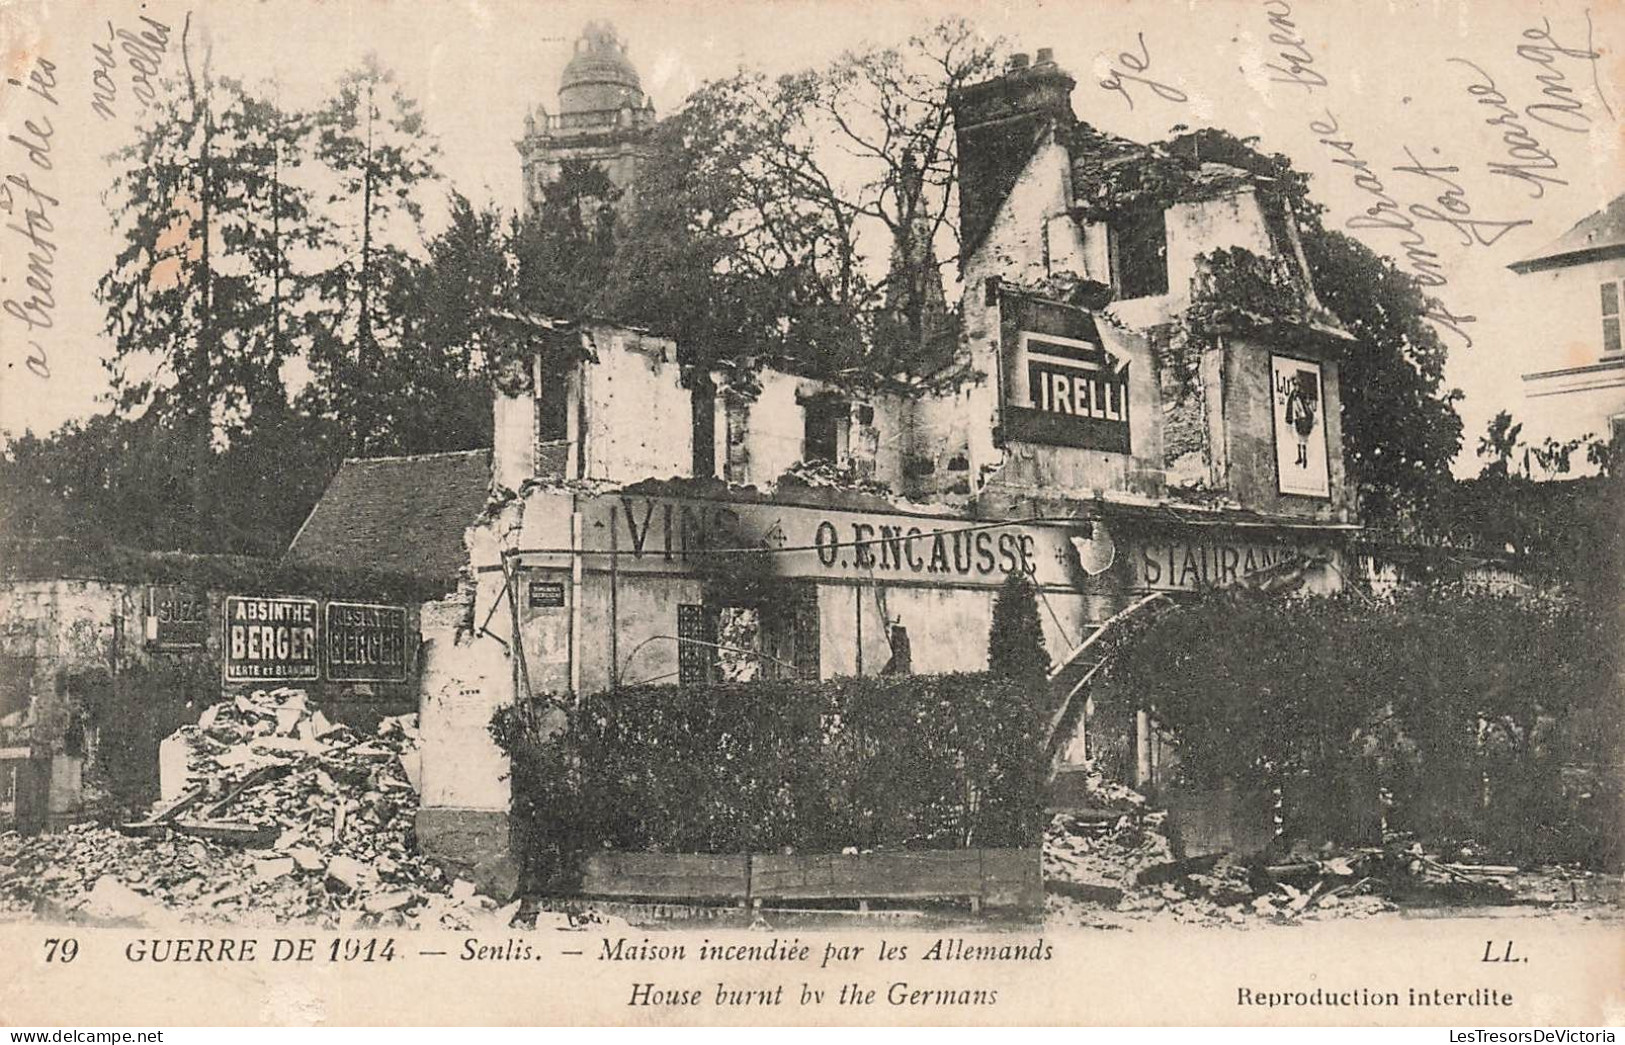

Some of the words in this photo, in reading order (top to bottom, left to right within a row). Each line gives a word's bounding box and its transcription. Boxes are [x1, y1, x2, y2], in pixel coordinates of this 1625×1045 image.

[1446, 58, 1568, 199] Marie
[8, 116, 54, 170] de
[235, 601, 312, 622] ABSINTHE
[231, 625, 315, 660] BERGER
[330, 631, 402, 665] BERGER
[229, 664, 260, 676] VERTE
[275, 665, 316, 677] BLANCHE
[44, 938, 79, 963] 79
[125, 938, 258, 962] GUERRE
[272, 938, 317, 962] DE
[460, 938, 541, 962] Senlis.
[598, 938, 685, 962] Maison
[700, 938, 809, 962] incendiée
[821, 942, 865, 968] par
[878, 939, 908, 962] les
[922, 938, 1053, 962] Allemands
[1482, 940, 1528, 963] LL.
[628, 983, 702, 1007] House
[715, 982, 782, 1006] burnt
[839, 983, 875, 1006] the
[887, 982, 998, 1006] Germans
[1237, 987, 1398, 1008] Reproduction
[1408, 988, 1513, 1007] interdite
